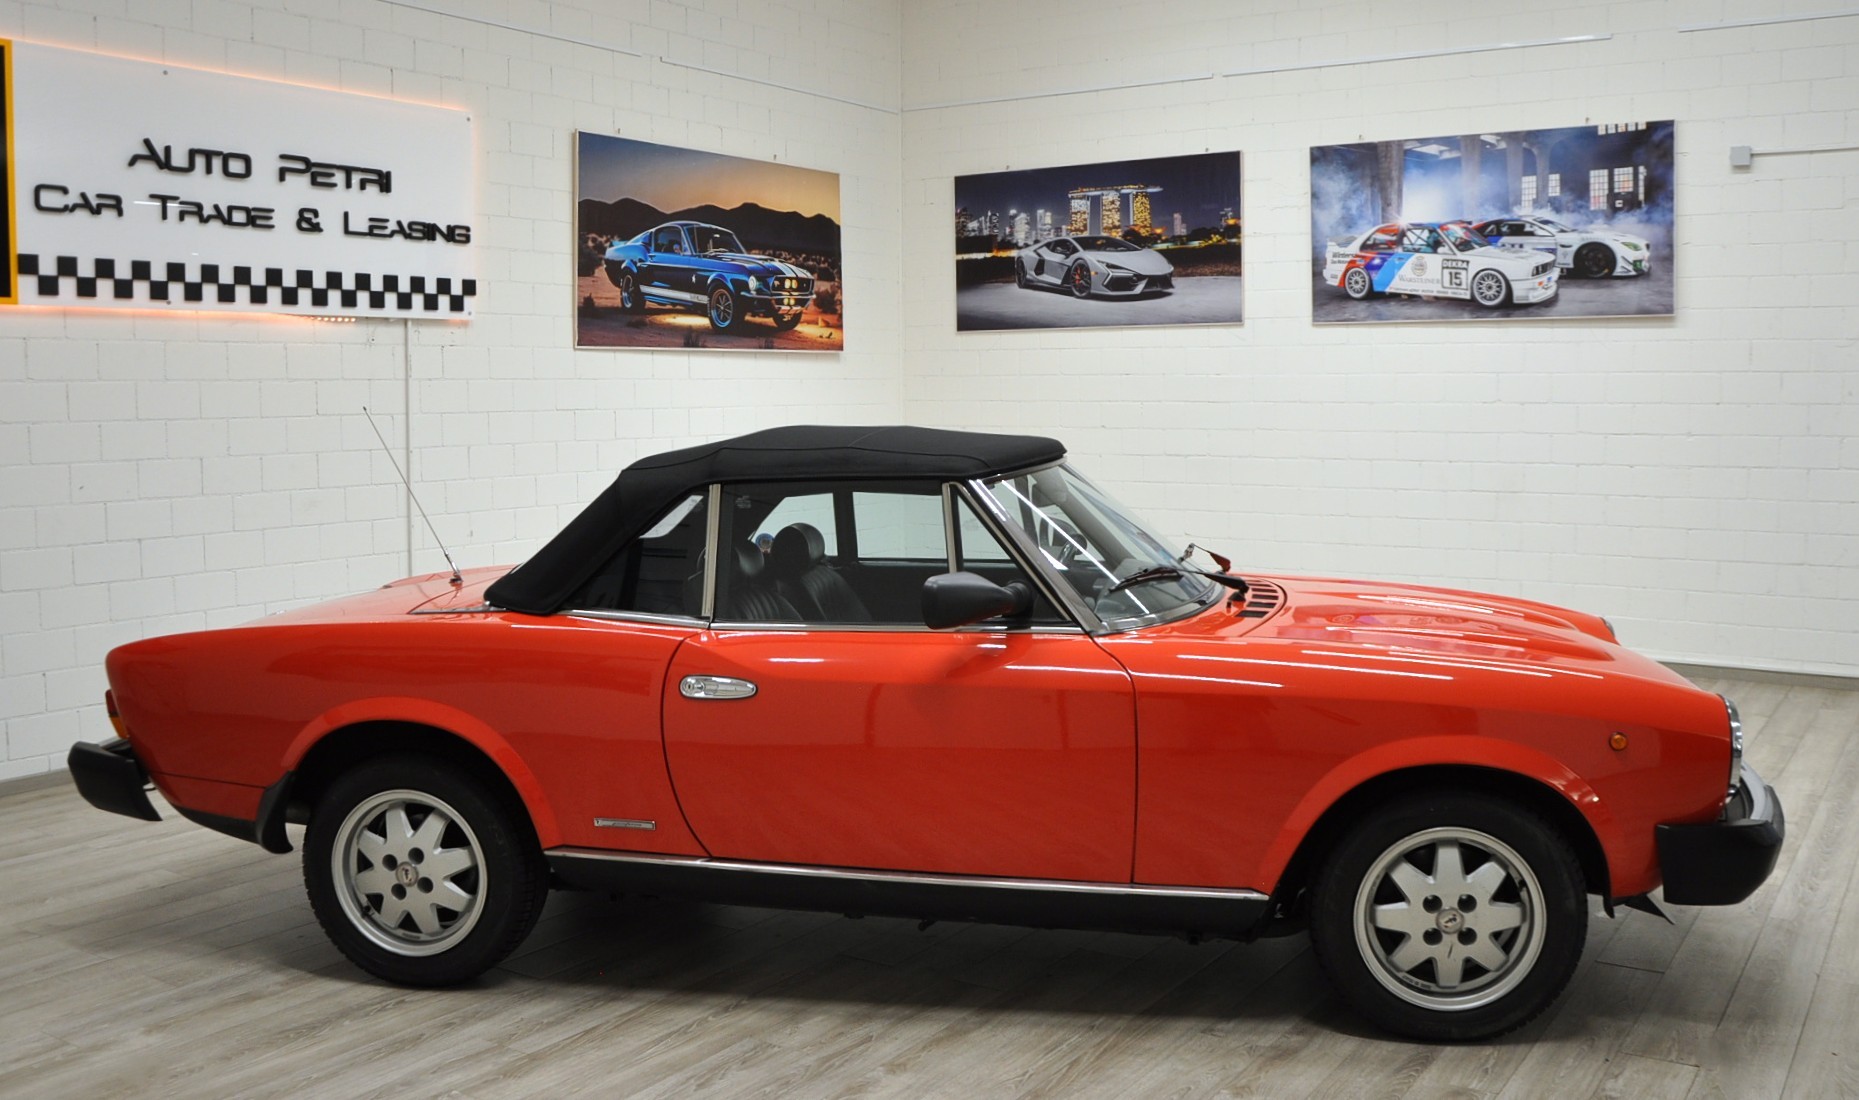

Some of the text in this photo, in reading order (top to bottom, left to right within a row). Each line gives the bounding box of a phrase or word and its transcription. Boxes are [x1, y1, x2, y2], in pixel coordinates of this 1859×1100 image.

[128, 137, 392, 194] AUTO PETRI
[33, 184, 472, 245] CAR TRADE & LEASING
[1443, 260, 1468, 268] DEKRA
[1449, 271, 1462, 286] 15
